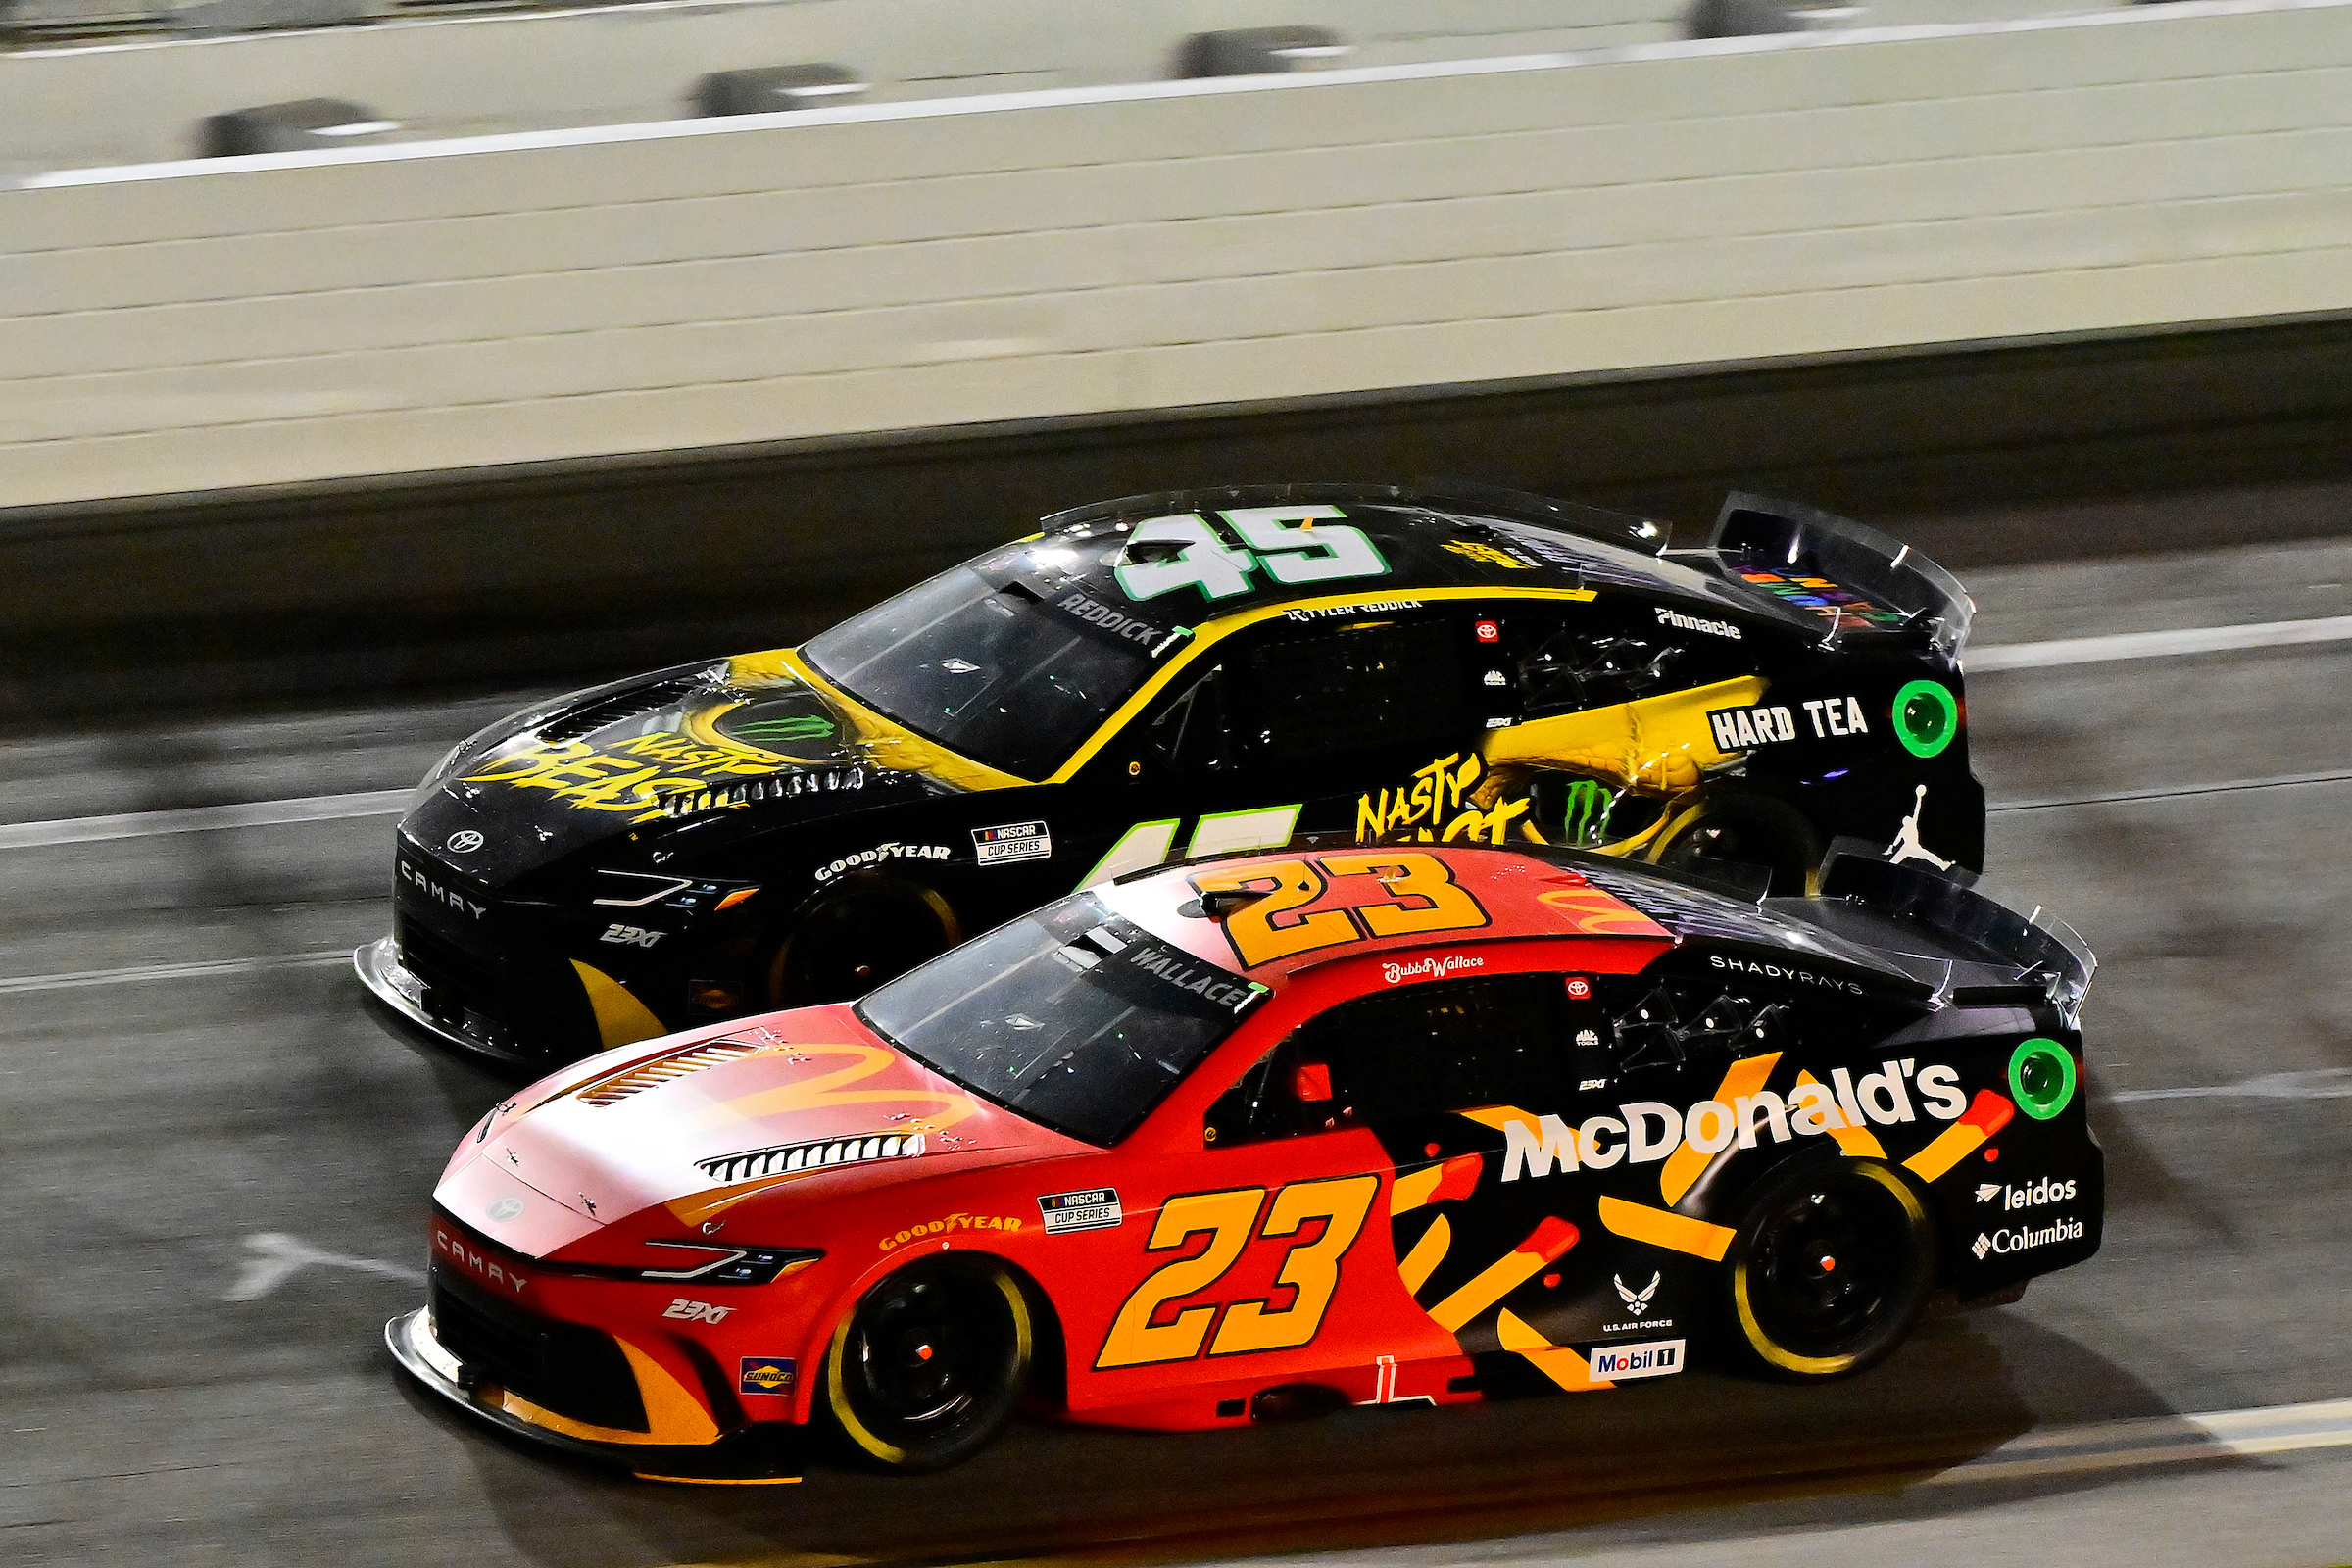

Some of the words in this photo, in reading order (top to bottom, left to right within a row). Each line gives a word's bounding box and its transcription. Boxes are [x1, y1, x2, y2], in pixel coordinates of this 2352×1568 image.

[1114, 505, 1392, 602] 45
[1057, 593, 1164, 646] REDDICK
[1305, 604, 1356, 618] TYLER
[1358, 599, 1422, 613] REDDICK
[1654, 607, 1742, 640] Pinnacle
[1712, 706, 1796, 749] HARD
[1802, 696, 1869, 738] TEA
[605, 732, 785, 776] NASTY
[1355, 752, 1481, 844] NASTY
[988, 844, 1006, 857] CUP
[1007, 840, 1040, 854] SERIES
[997, 825, 1036, 840] NASCAR
[814, 842, 951, 881] GOODYEAR
[401, 859, 487, 920] CAMRY
[1186, 853, 1493, 970] 23
[1130, 947, 1248, 1006] WALLACE
[1382, 960, 1431, 984] Bubba
[1425, 956, 1484, 978] Wallace
[1500, 1058, 1968, 1183] McDonald's
[1063, 1192, 1105, 1207] NASCAR
[2004, 1176, 2077, 1211] leidos
[878, 1212, 1022, 1250] GOODYEAR
[1054, 1212, 1075, 1224] CUP
[1076, 1207, 1110, 1221] SERIES
[1992, 1217, 2083, 1253] Columbia
[437, 1229, 528, 1293] CAMRY
[1092, 1174, 1380, 1369] 23
[1602, 1324, 1620, 1333] U.S.
[1639, 1319, 1673, 1329] FORCE
[1598, 1350, 1653, 1373] Mobil
